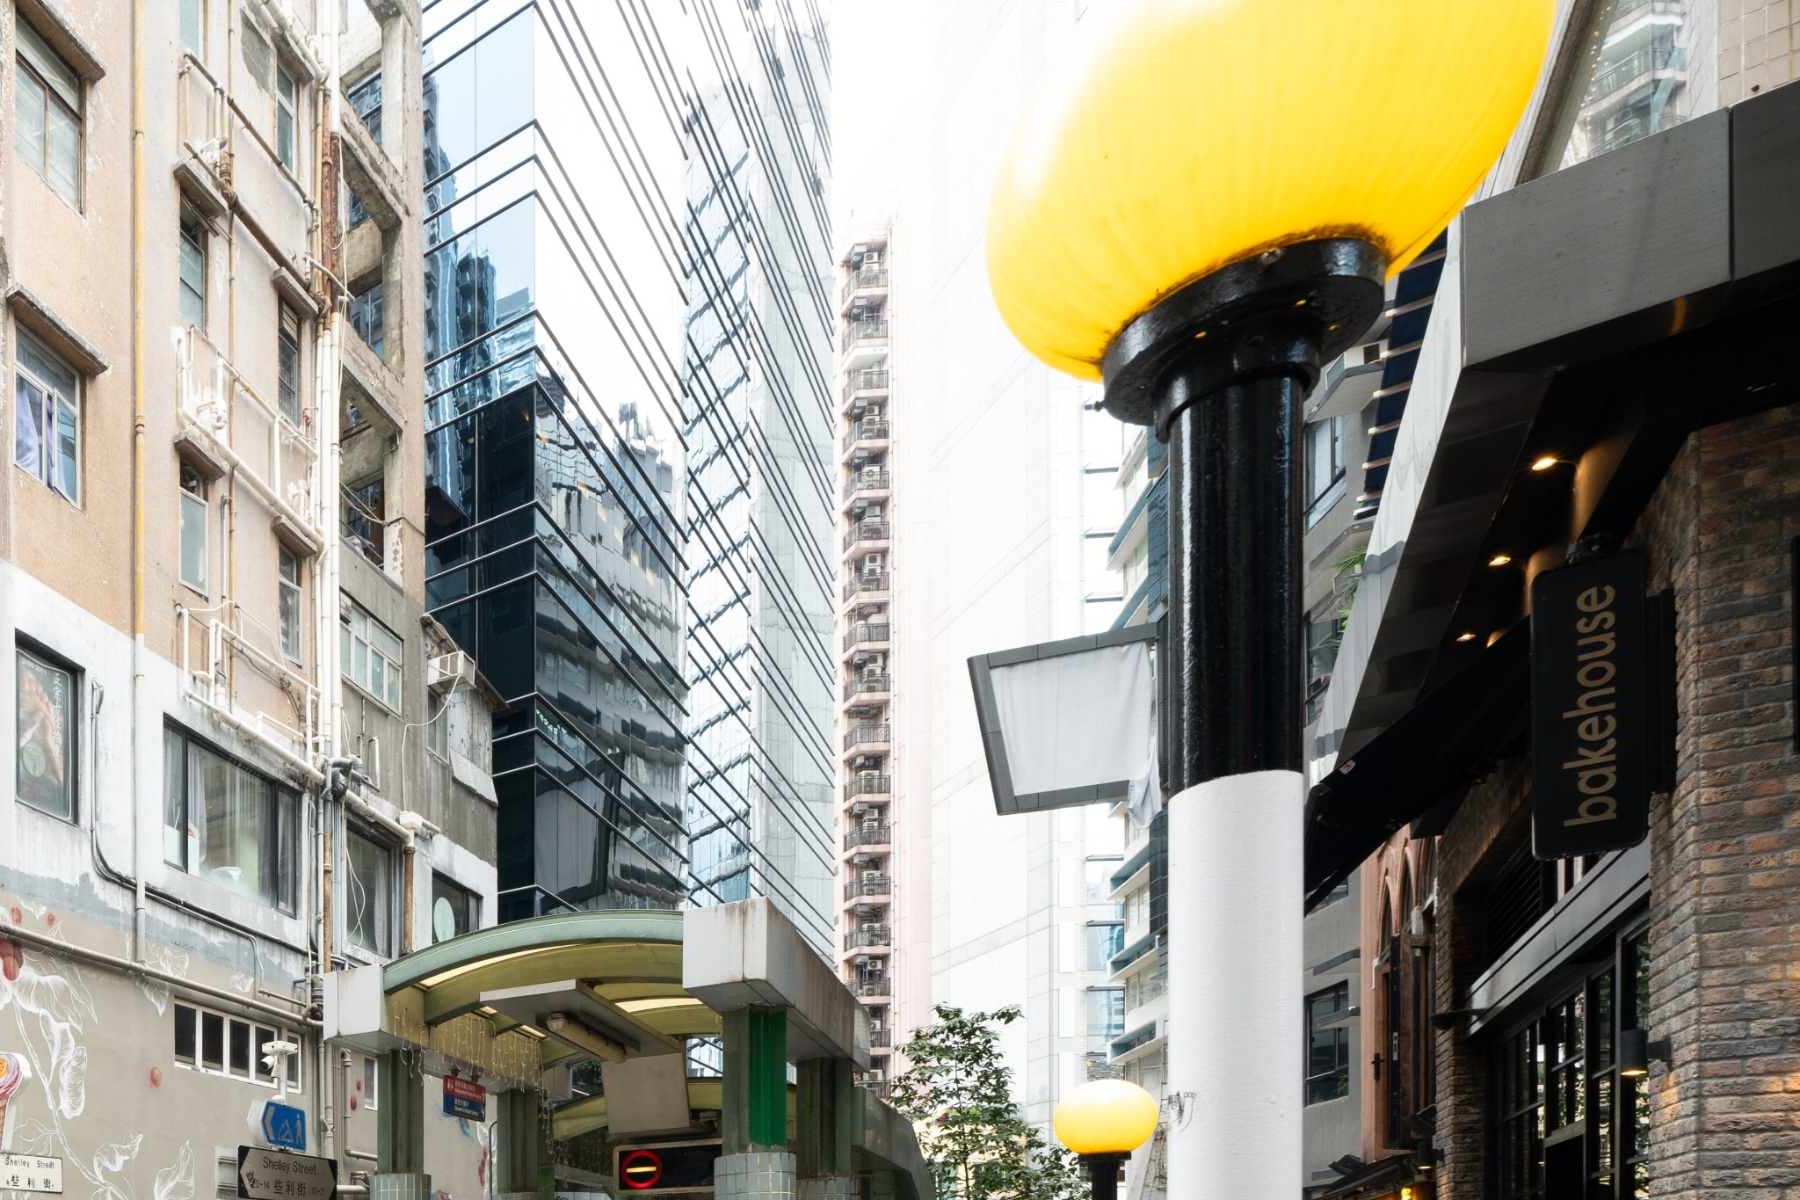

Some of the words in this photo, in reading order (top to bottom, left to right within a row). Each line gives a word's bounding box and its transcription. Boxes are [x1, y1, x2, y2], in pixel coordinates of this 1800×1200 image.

[1563, 584, 1616, 827] bakehouse
[5, 1156, 30, 1168] Shelley
[37, 1160, 55, 1169] Street
[263, 1157, 290, 1174] Shelley
[293, 1161, 316, 1176] Street
[11, 1174, 51, 1189] 些利街
[274, 1179, 306, 1197] 些利街
